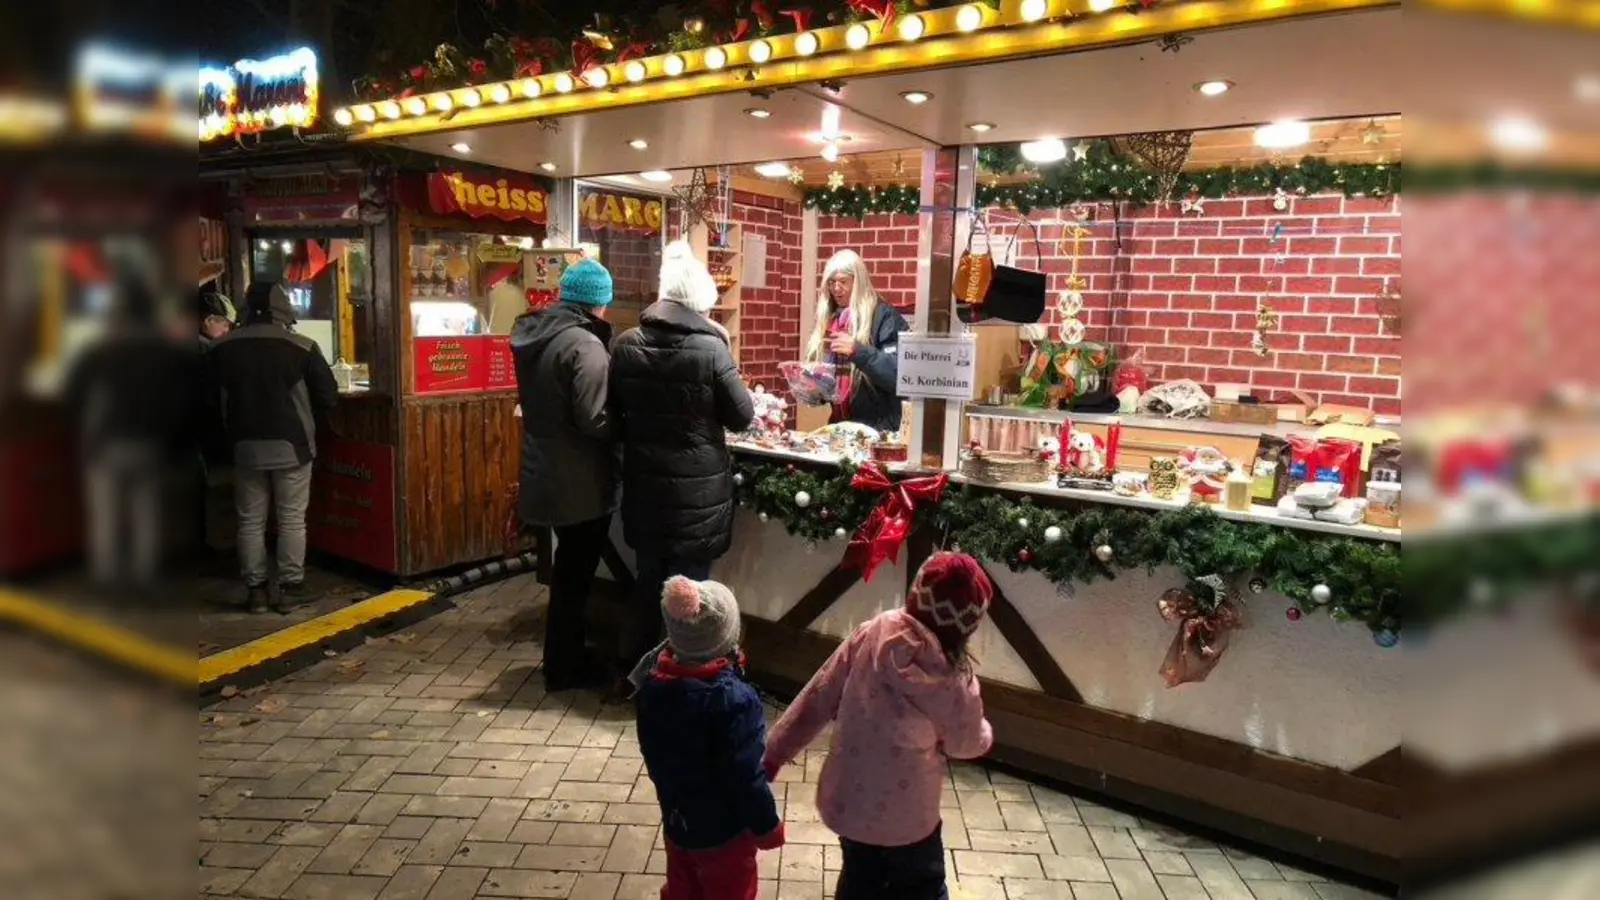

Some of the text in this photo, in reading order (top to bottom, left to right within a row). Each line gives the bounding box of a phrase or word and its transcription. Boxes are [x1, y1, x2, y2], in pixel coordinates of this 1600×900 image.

[454, 172, 550, 213] heiss
[904, 351, 952, 362] Die Pfarrei
[901, 375, 969, 388] St. Korbinian
